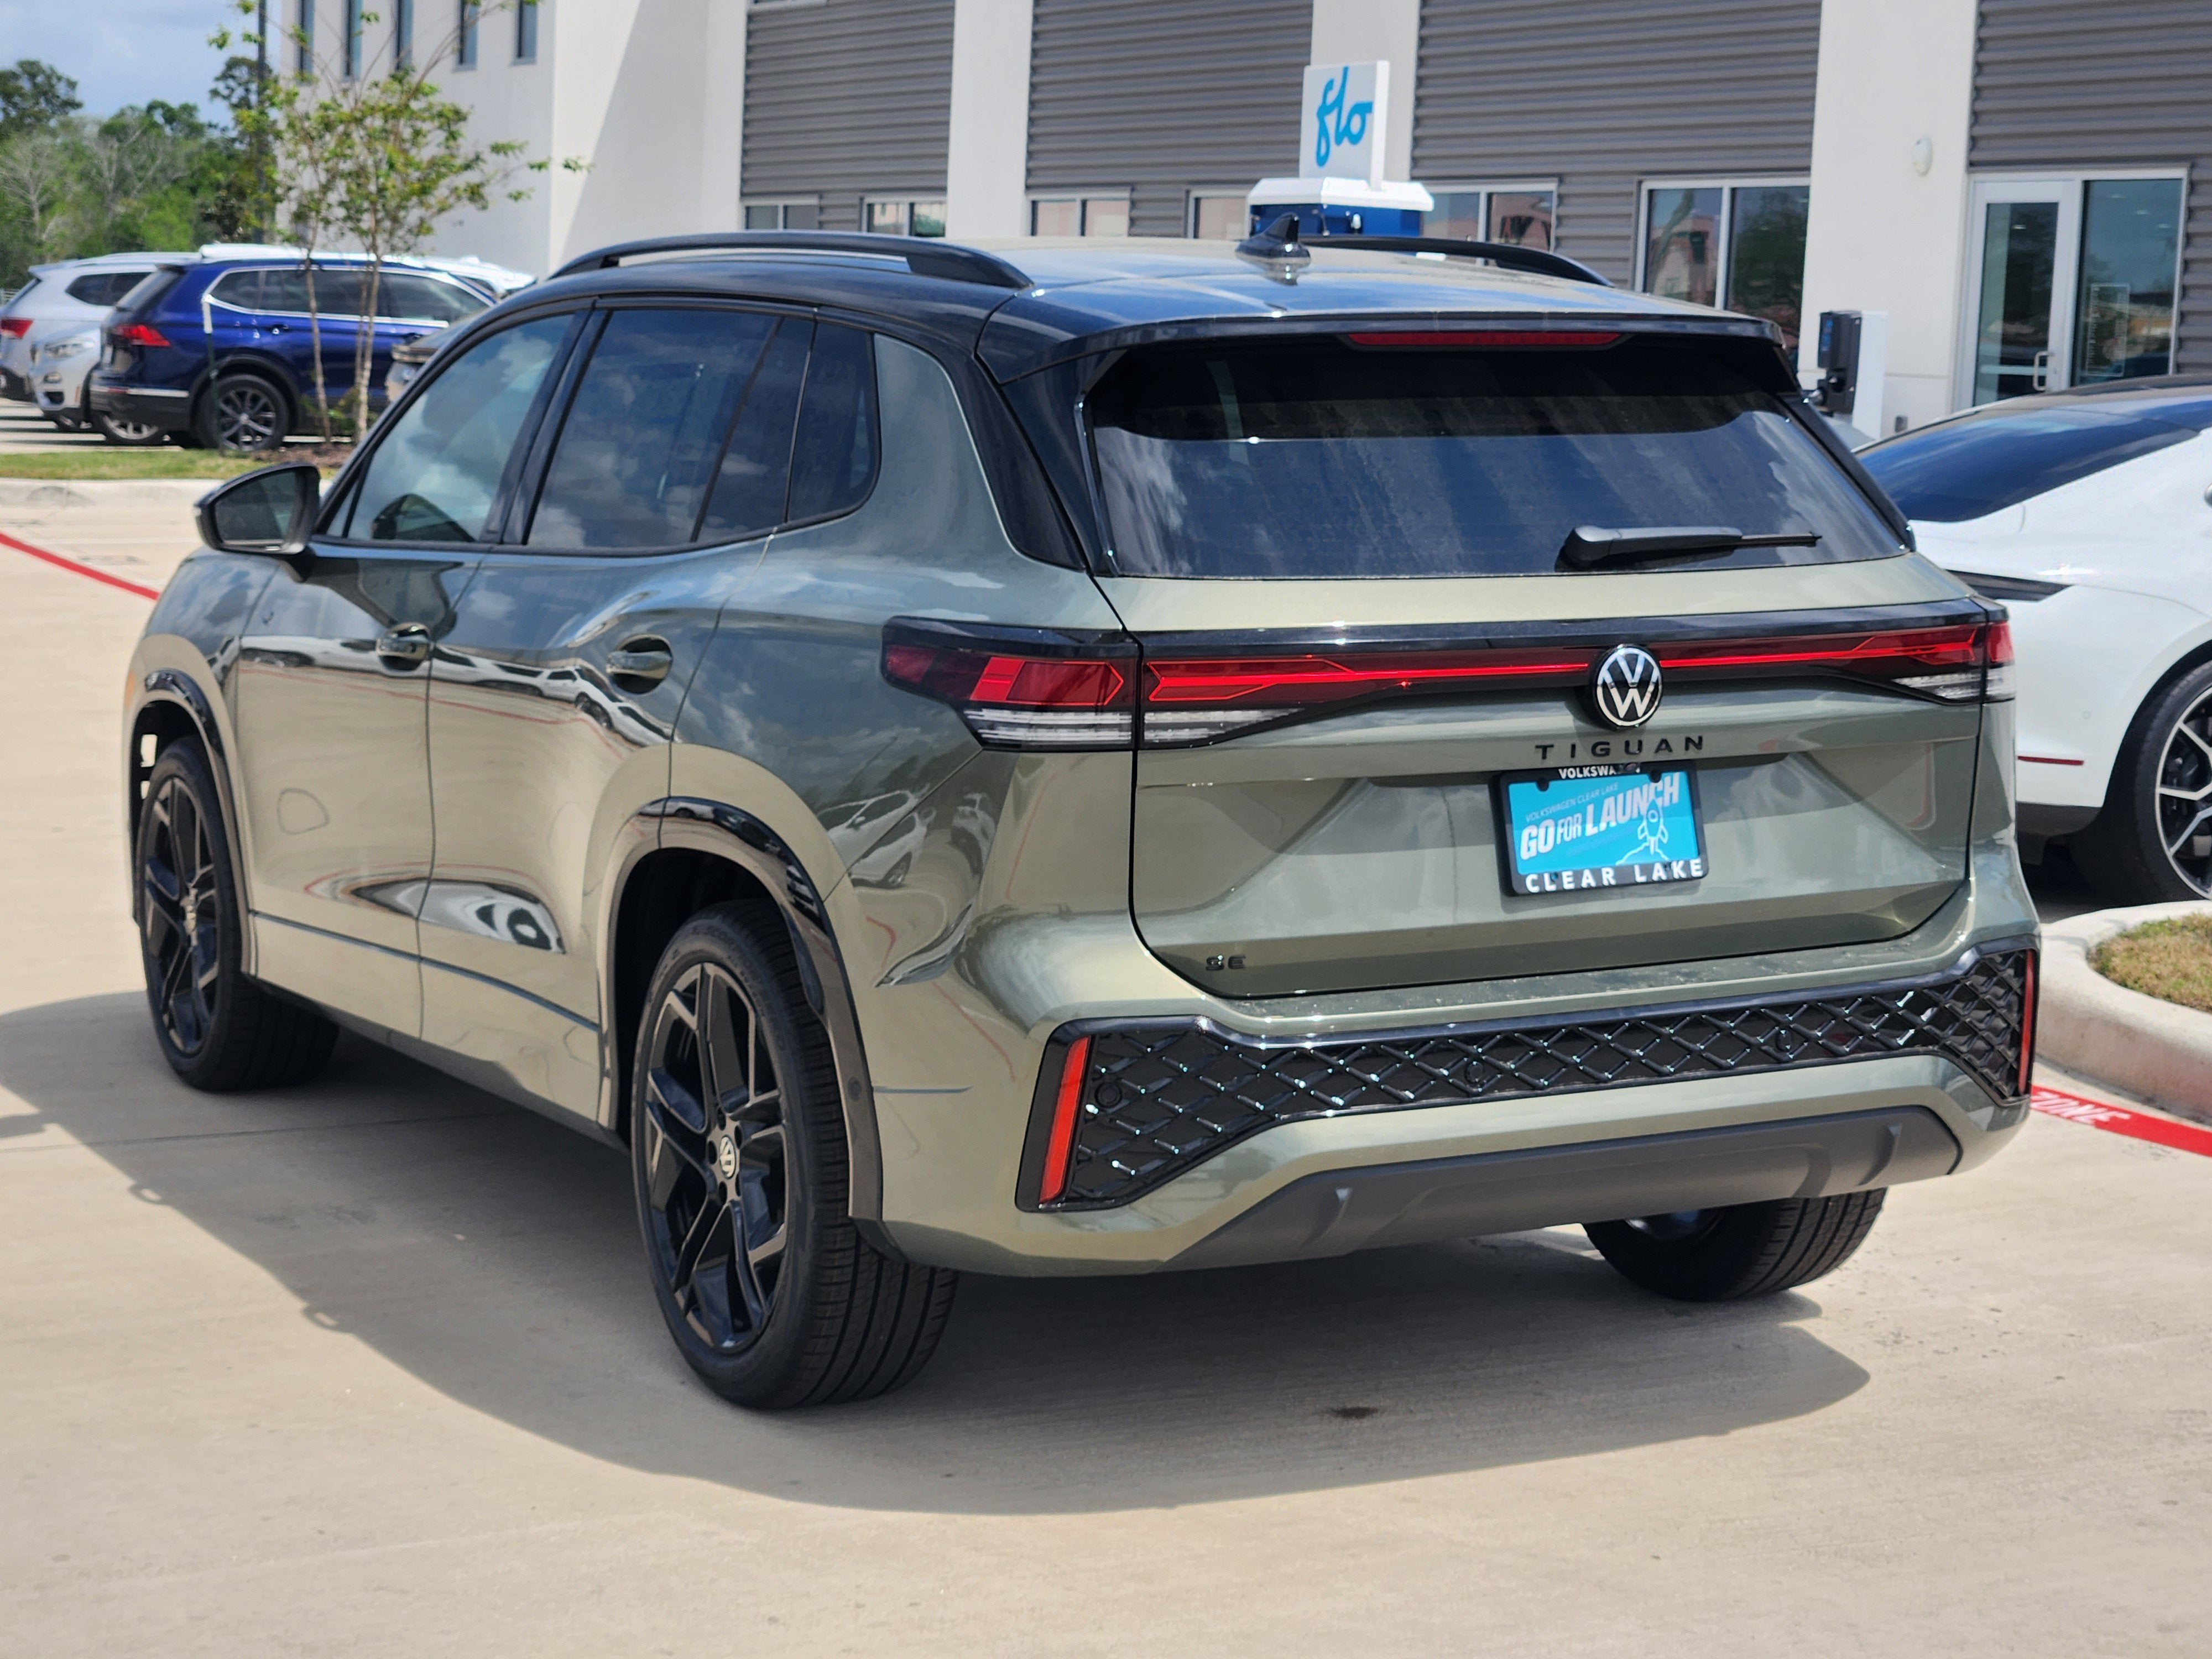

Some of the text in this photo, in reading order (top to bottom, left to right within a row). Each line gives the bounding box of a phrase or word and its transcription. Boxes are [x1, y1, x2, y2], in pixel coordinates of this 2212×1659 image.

[1316, 66, 1373, 168] flo
[1597, 648, 1661, 726] VW
[1535, 736, 1704, 759] TIGUAN
[1558, 764, 1641, 779] VOLKSWA
[1520, 819, 1557, 860] GO
[1556, 812, 1582, 844] FOR
[1585, 772, 1680, 836] LAUNCH
[1525, 781, 1619, 822] VOLKSWAGEN CLEAR LAKE
[1525, 858, 1704, 894] CLEAR LAKE
[1206, 954, 1245, 971] SE
